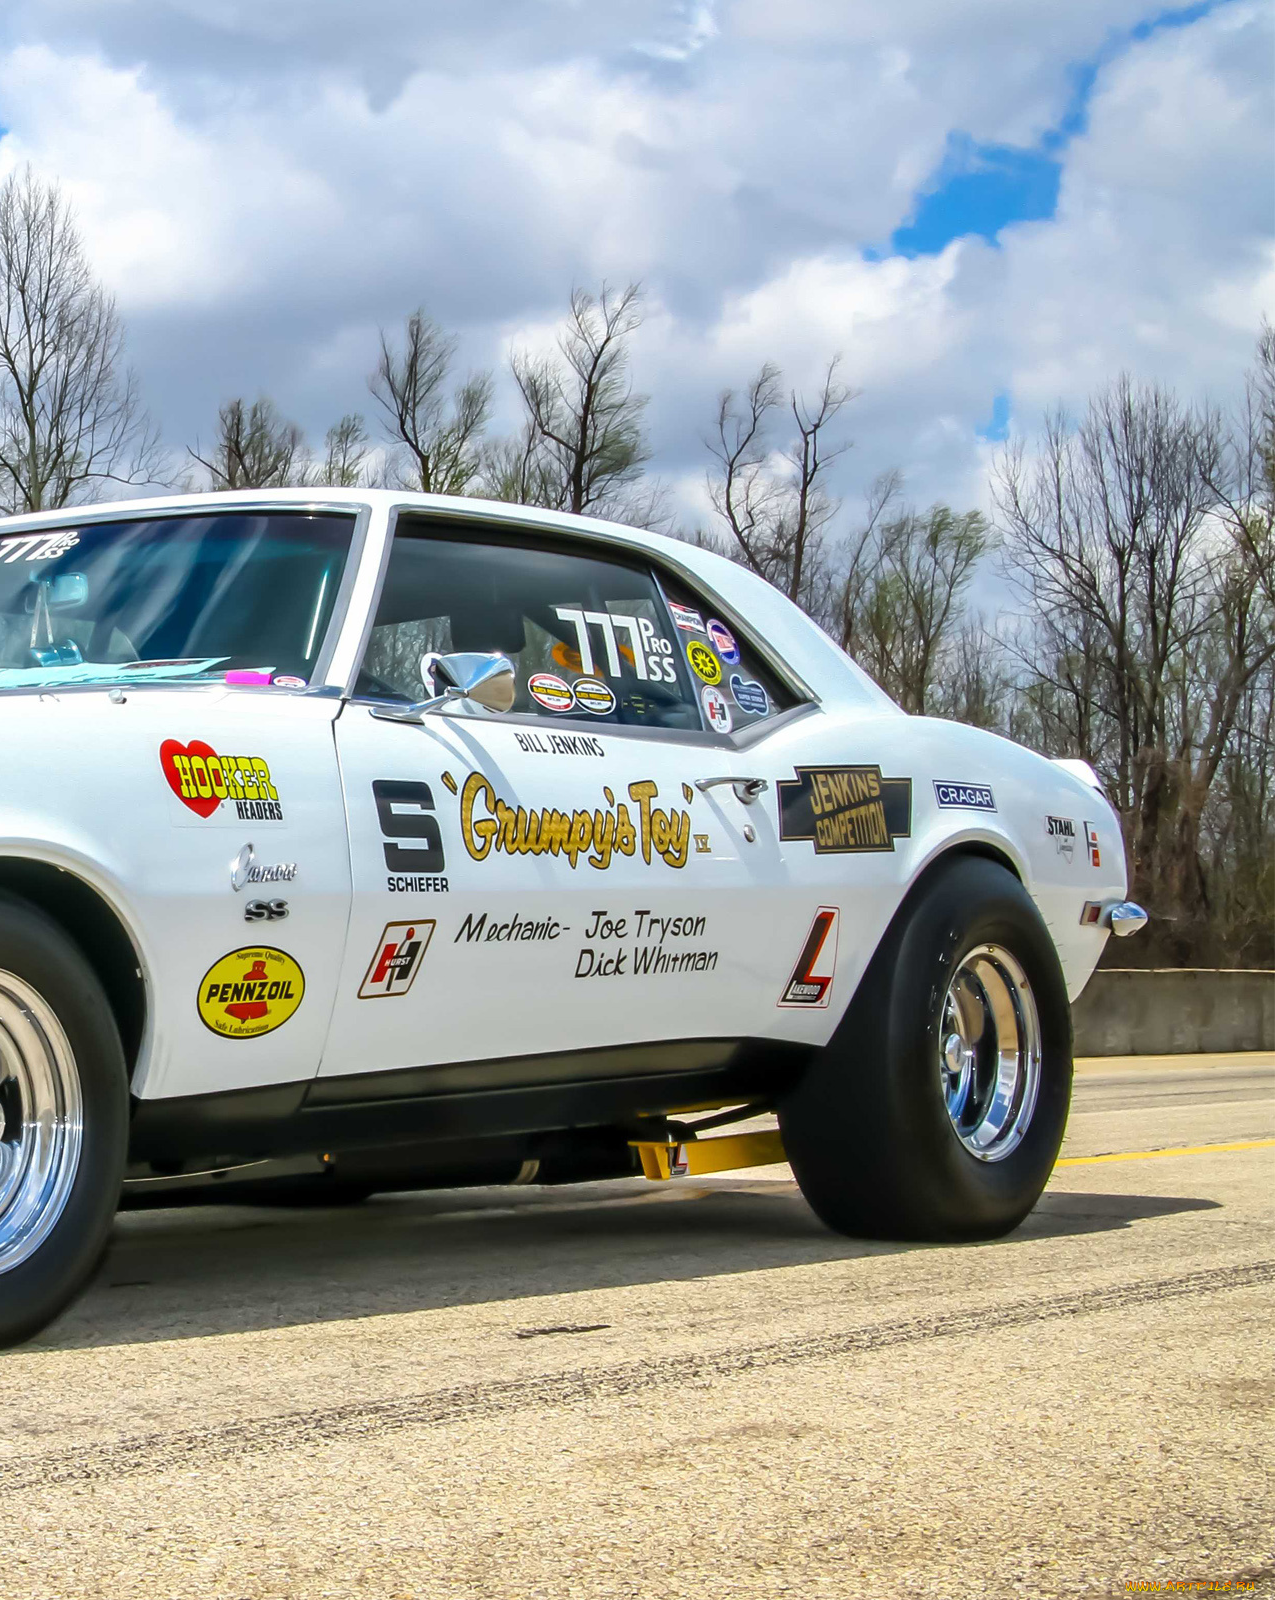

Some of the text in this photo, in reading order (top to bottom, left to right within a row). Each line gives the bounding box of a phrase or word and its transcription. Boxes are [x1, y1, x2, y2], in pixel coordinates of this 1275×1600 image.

[36, 546, 71, 560] SS
[556, 608, 647, 680] 777
[647, 655, 676, 683] SS
[514, 733, 606, 757] BILL JENKINS
[172, 754, 279, 801] HOOKER
[810, 773, 881, 815] JENKINS
[939, 787, 993, 807] CRAGAR
[236, 801, 284, 820] HEADERS
[816, 801, 889, 846] COMPETITION
[1047, 816, 1075, 836] STAHL
[387, 877, 450, 893] SCHIEFER
[244, 898, 290, 923] SS
[585, 911, 629, 939] Joe
[634, 910, 707, 944] Tryson
[384, 957, 411, 967] HURST
[574, 946, 719, 979] Dick Whitman
[205, 981, 295, 1004] PENNZOIL
[214, 1020, 228, 1032] Safe
